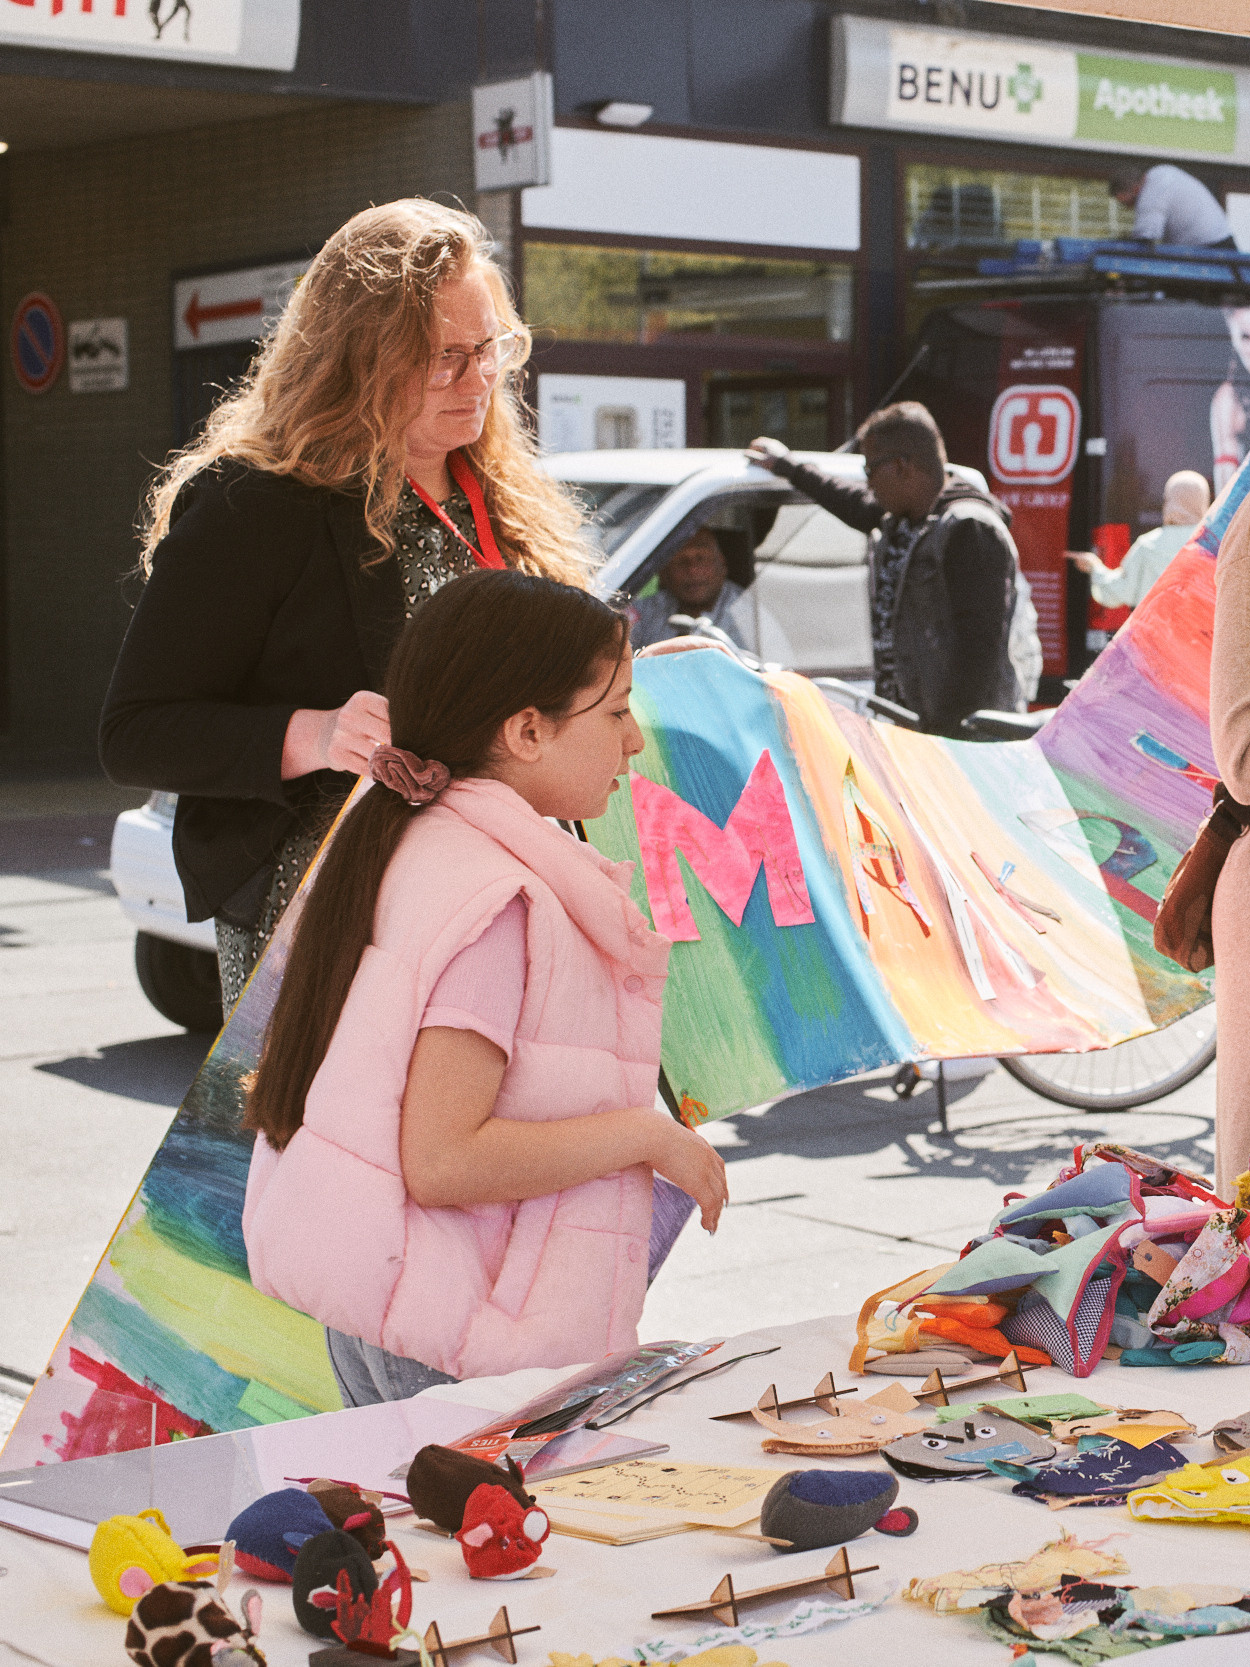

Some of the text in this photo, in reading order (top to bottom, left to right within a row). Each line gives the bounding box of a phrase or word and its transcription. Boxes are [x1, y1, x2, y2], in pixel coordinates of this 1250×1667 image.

[899, 64, 1226, 123] BENU Apotheek
[470, 1439, 500, 1447] TIES
